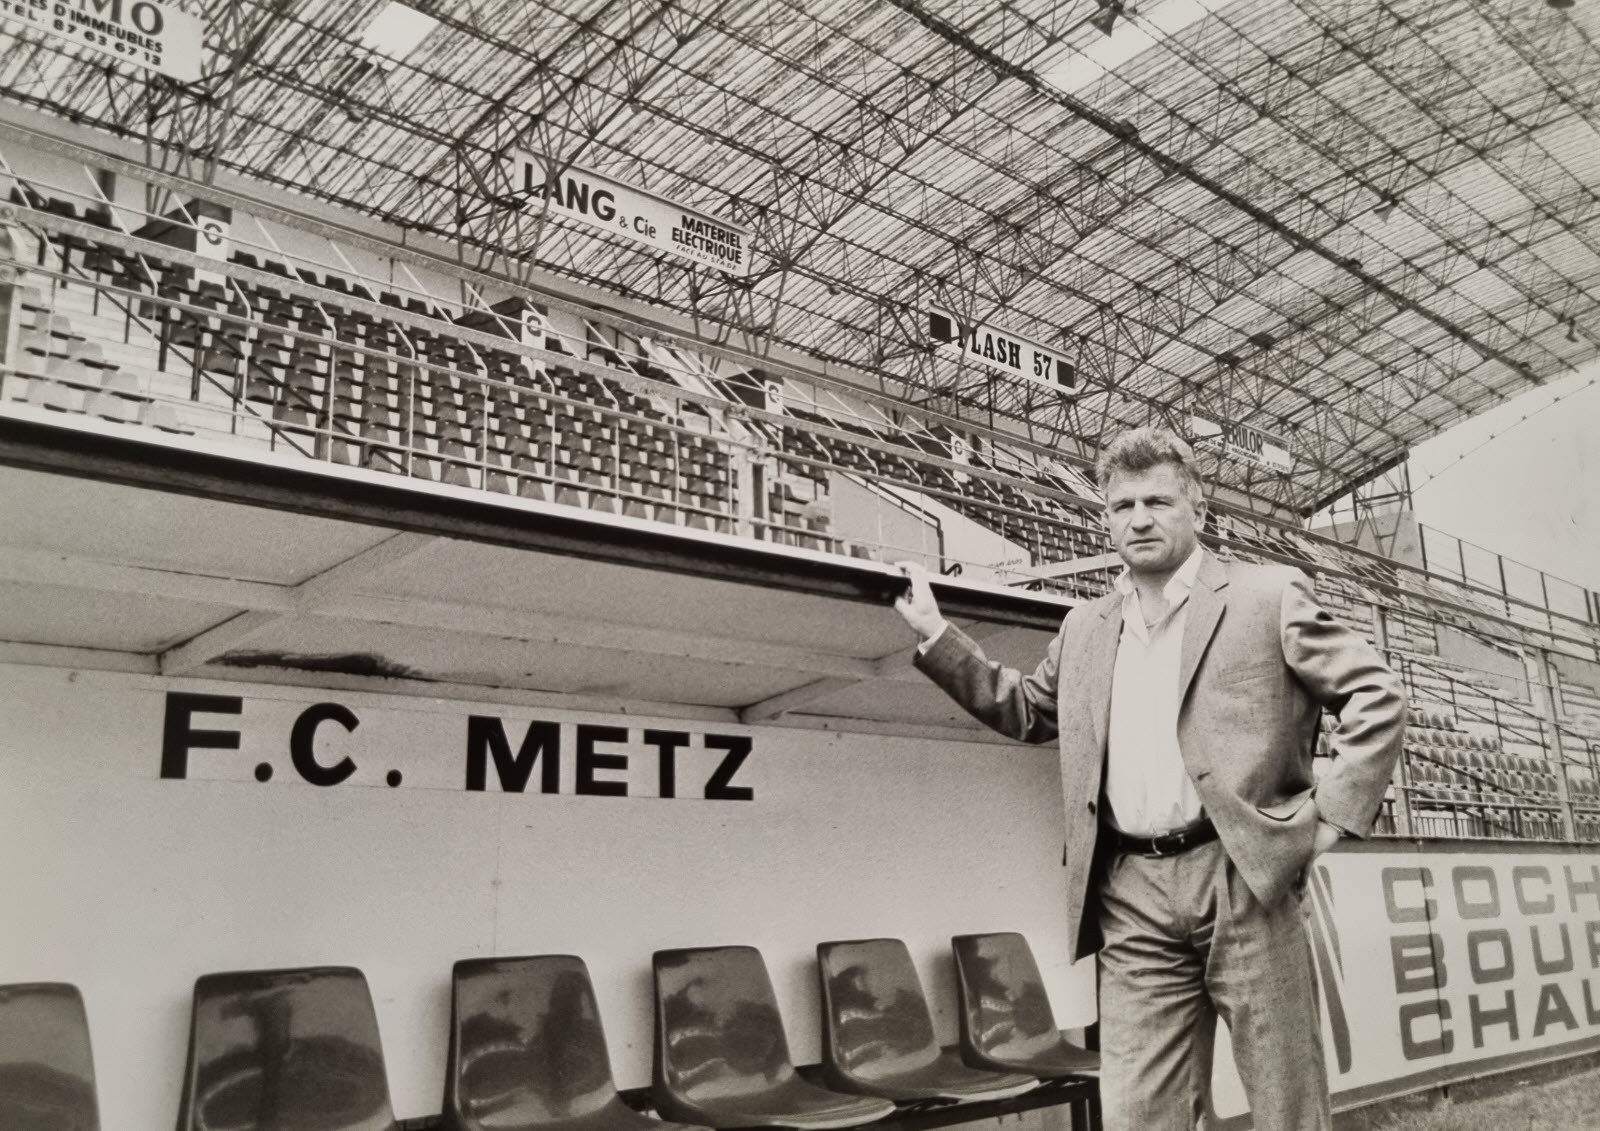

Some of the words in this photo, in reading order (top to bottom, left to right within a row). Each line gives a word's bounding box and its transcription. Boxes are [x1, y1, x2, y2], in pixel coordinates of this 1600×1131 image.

[53, 3, 163, 54] D'IMMEUBLES
[53, 18, 77, 34] 87
[84, 30, 108, 46] 63
[114, 41, 138, 57] 67
[143, 51, 162, 66] 13
[524, 162, 617, 222] LANG
[618, 215, 629, 230] &
[633, 215, 657, 239] Cie
[672, 227, 742, 265] ELECTRIQUE
[1032, 350, 1052, 380] 57
[160, 690, 403, 788] F.C.
[465, 715, 755, 801] METZ
